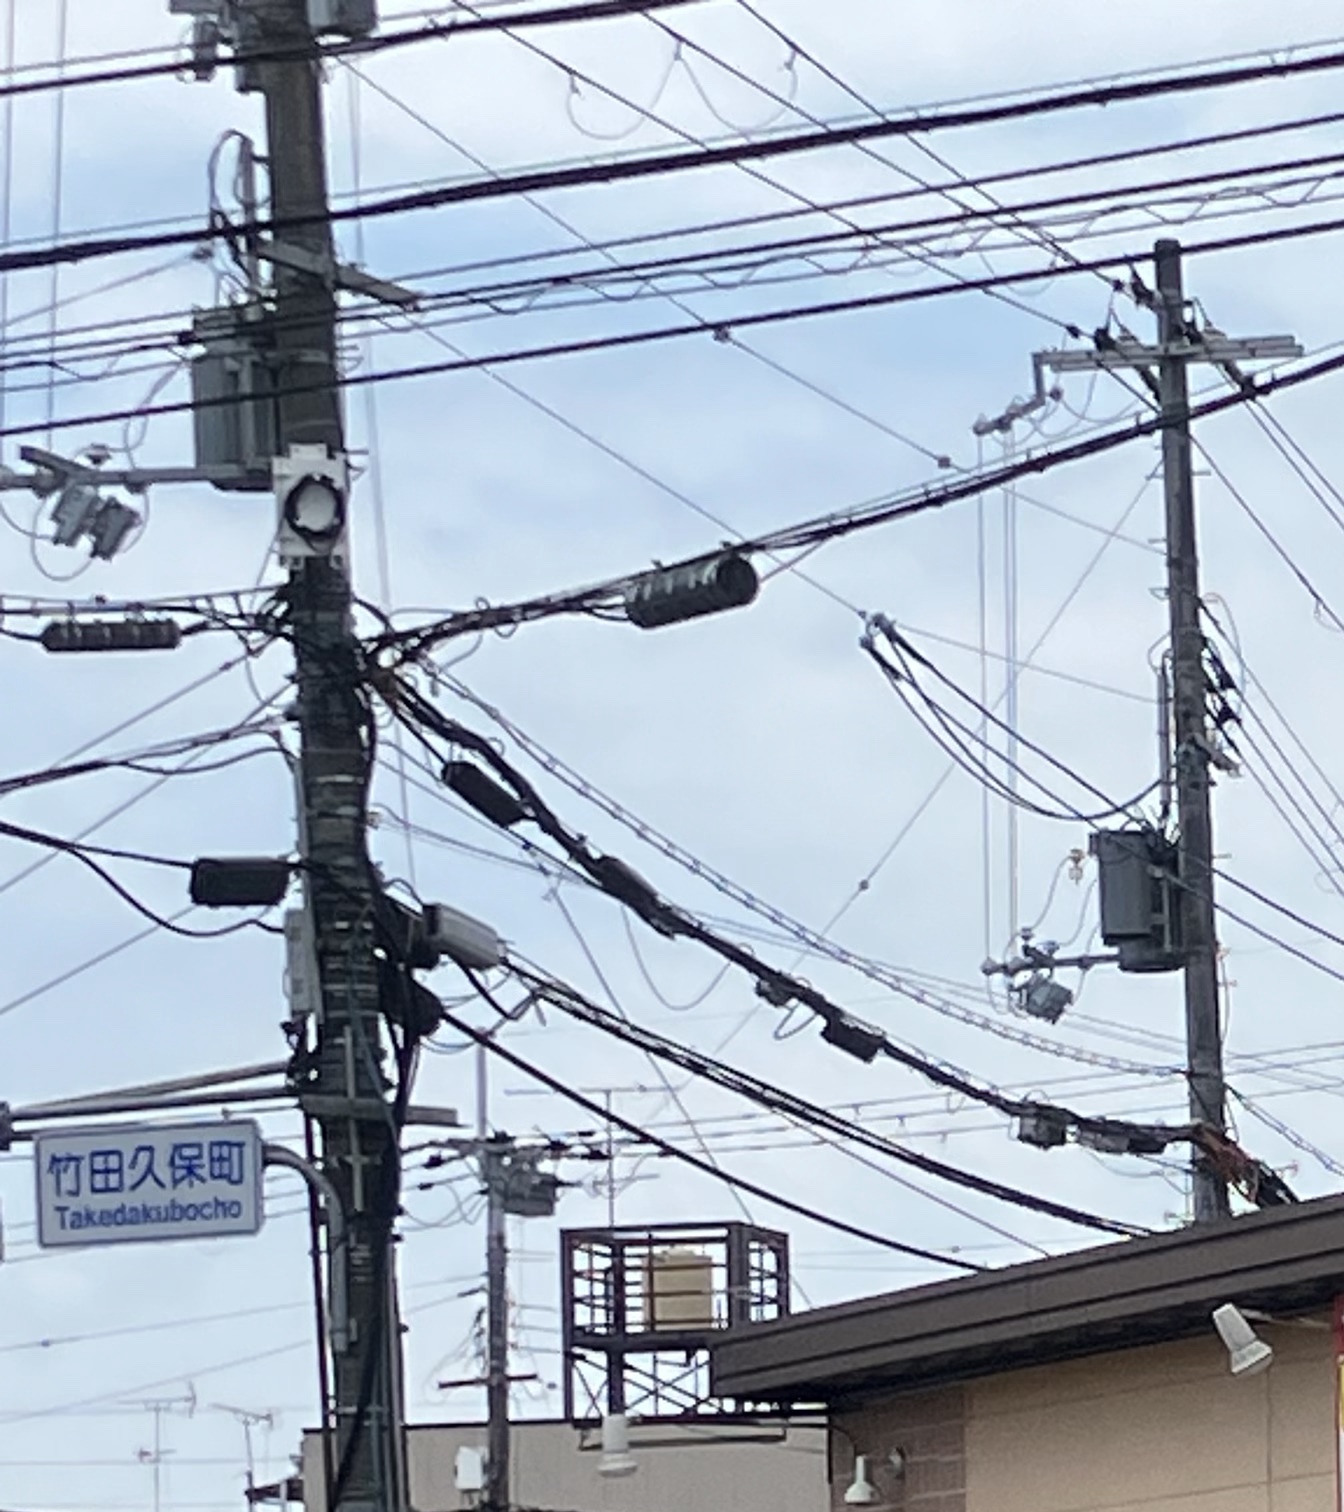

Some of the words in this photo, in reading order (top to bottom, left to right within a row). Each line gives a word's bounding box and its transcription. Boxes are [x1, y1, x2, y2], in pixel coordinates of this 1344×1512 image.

[47, 1139, 247, 1198] 竹田久保町
[54, 1197, 243, 1232] Takedakubocho
